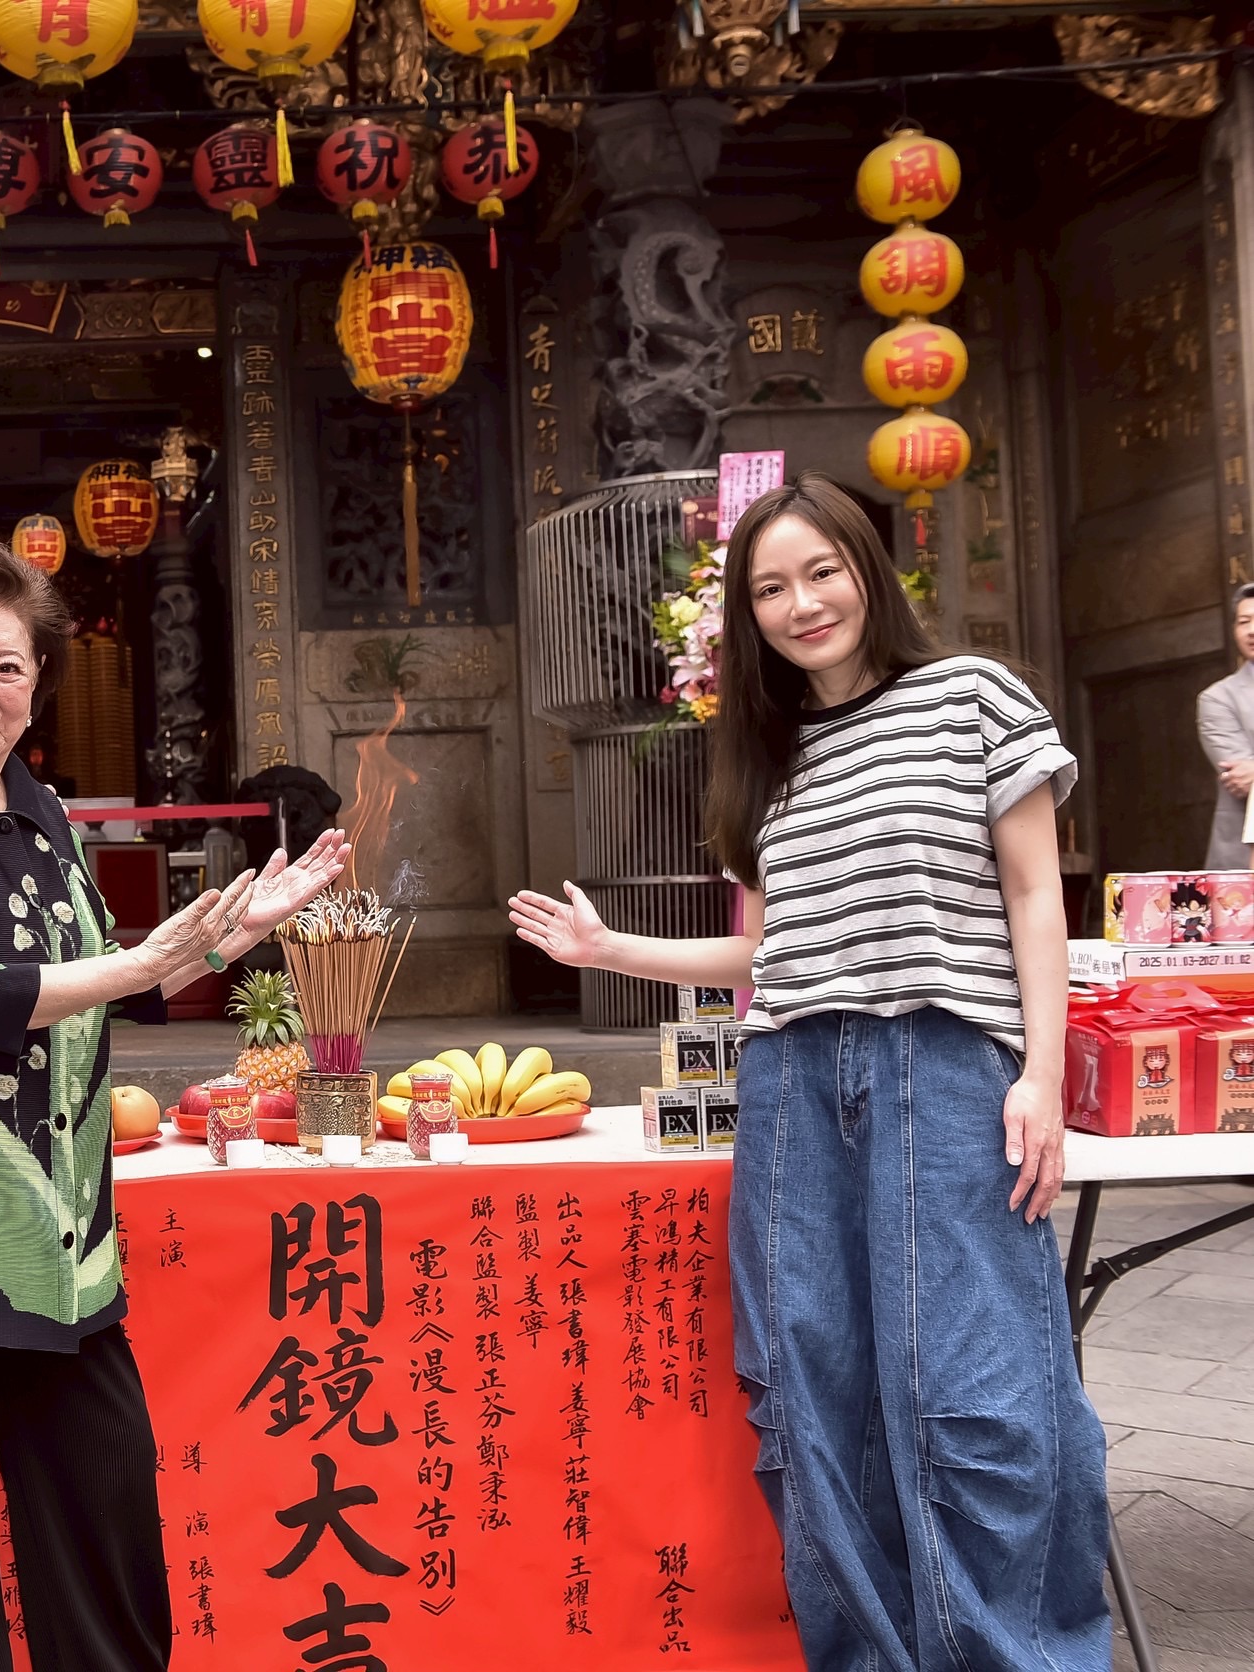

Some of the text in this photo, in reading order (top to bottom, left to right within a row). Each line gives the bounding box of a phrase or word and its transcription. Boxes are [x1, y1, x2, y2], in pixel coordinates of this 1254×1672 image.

[682, 1049, 712, 1068] EX
[664, 1114, 693, 1132] EX
[711, 1113, 737, 1131] EX
[159, 1208, 186, 1268] 主演
[235, 1193, 410, 1672] 開鏡大吉
[655, 1542, 695, 1654] 聯合出品
